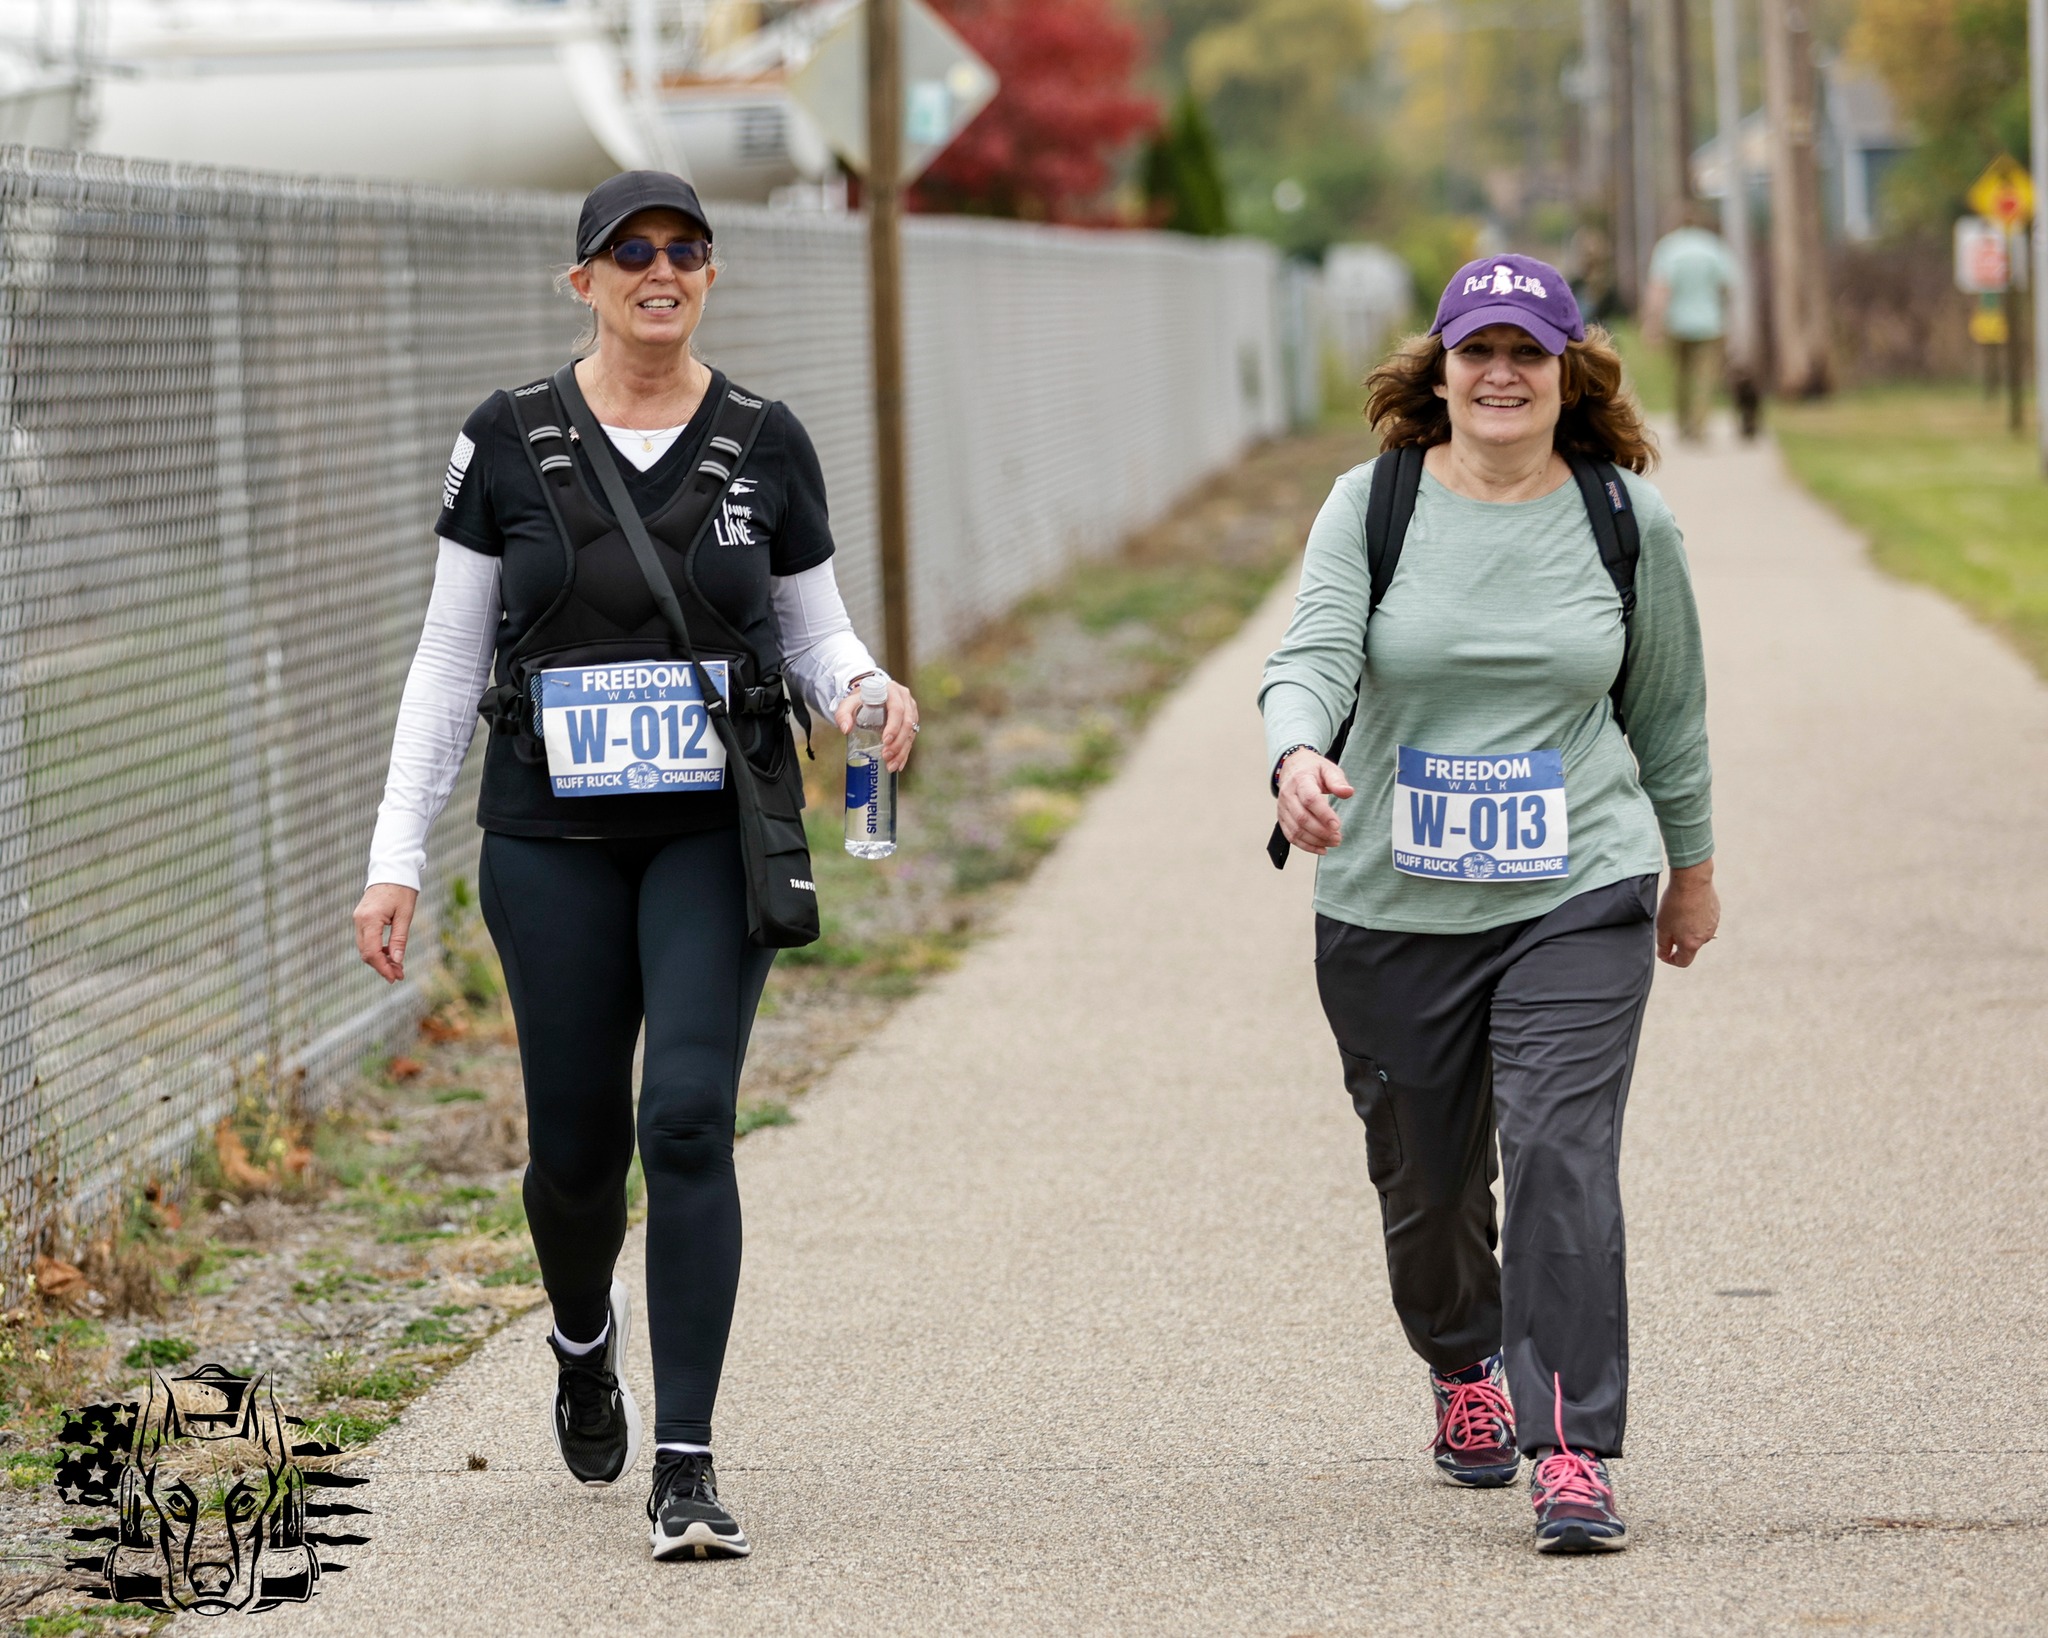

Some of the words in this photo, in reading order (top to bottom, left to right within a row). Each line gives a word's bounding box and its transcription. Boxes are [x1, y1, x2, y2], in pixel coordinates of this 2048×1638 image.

[713, 498, 756, 546] LINE
[582, 666, 692, 693] FREEDOM
[607, 689, 667, 701] WALK
[565, 704, 708, 765] W-012
[555, 775, 585, 790] RUFF
[586, 773, 623, 788] RUCK
[661, 770, 721, 784] CHALLENGE
[1424, 757, 1532, 781] FREEDOM
[866, 757, 879, 834] smartwater
[1448, 781, 1508, 792] WALK
[1409, 791, 1547, 851] W-013
[1396, 852, 1422, 869] RUFF
[1423, 860, 1459, 873] RUCK
[1497, 858, 1563, 874] CHALLENGE
